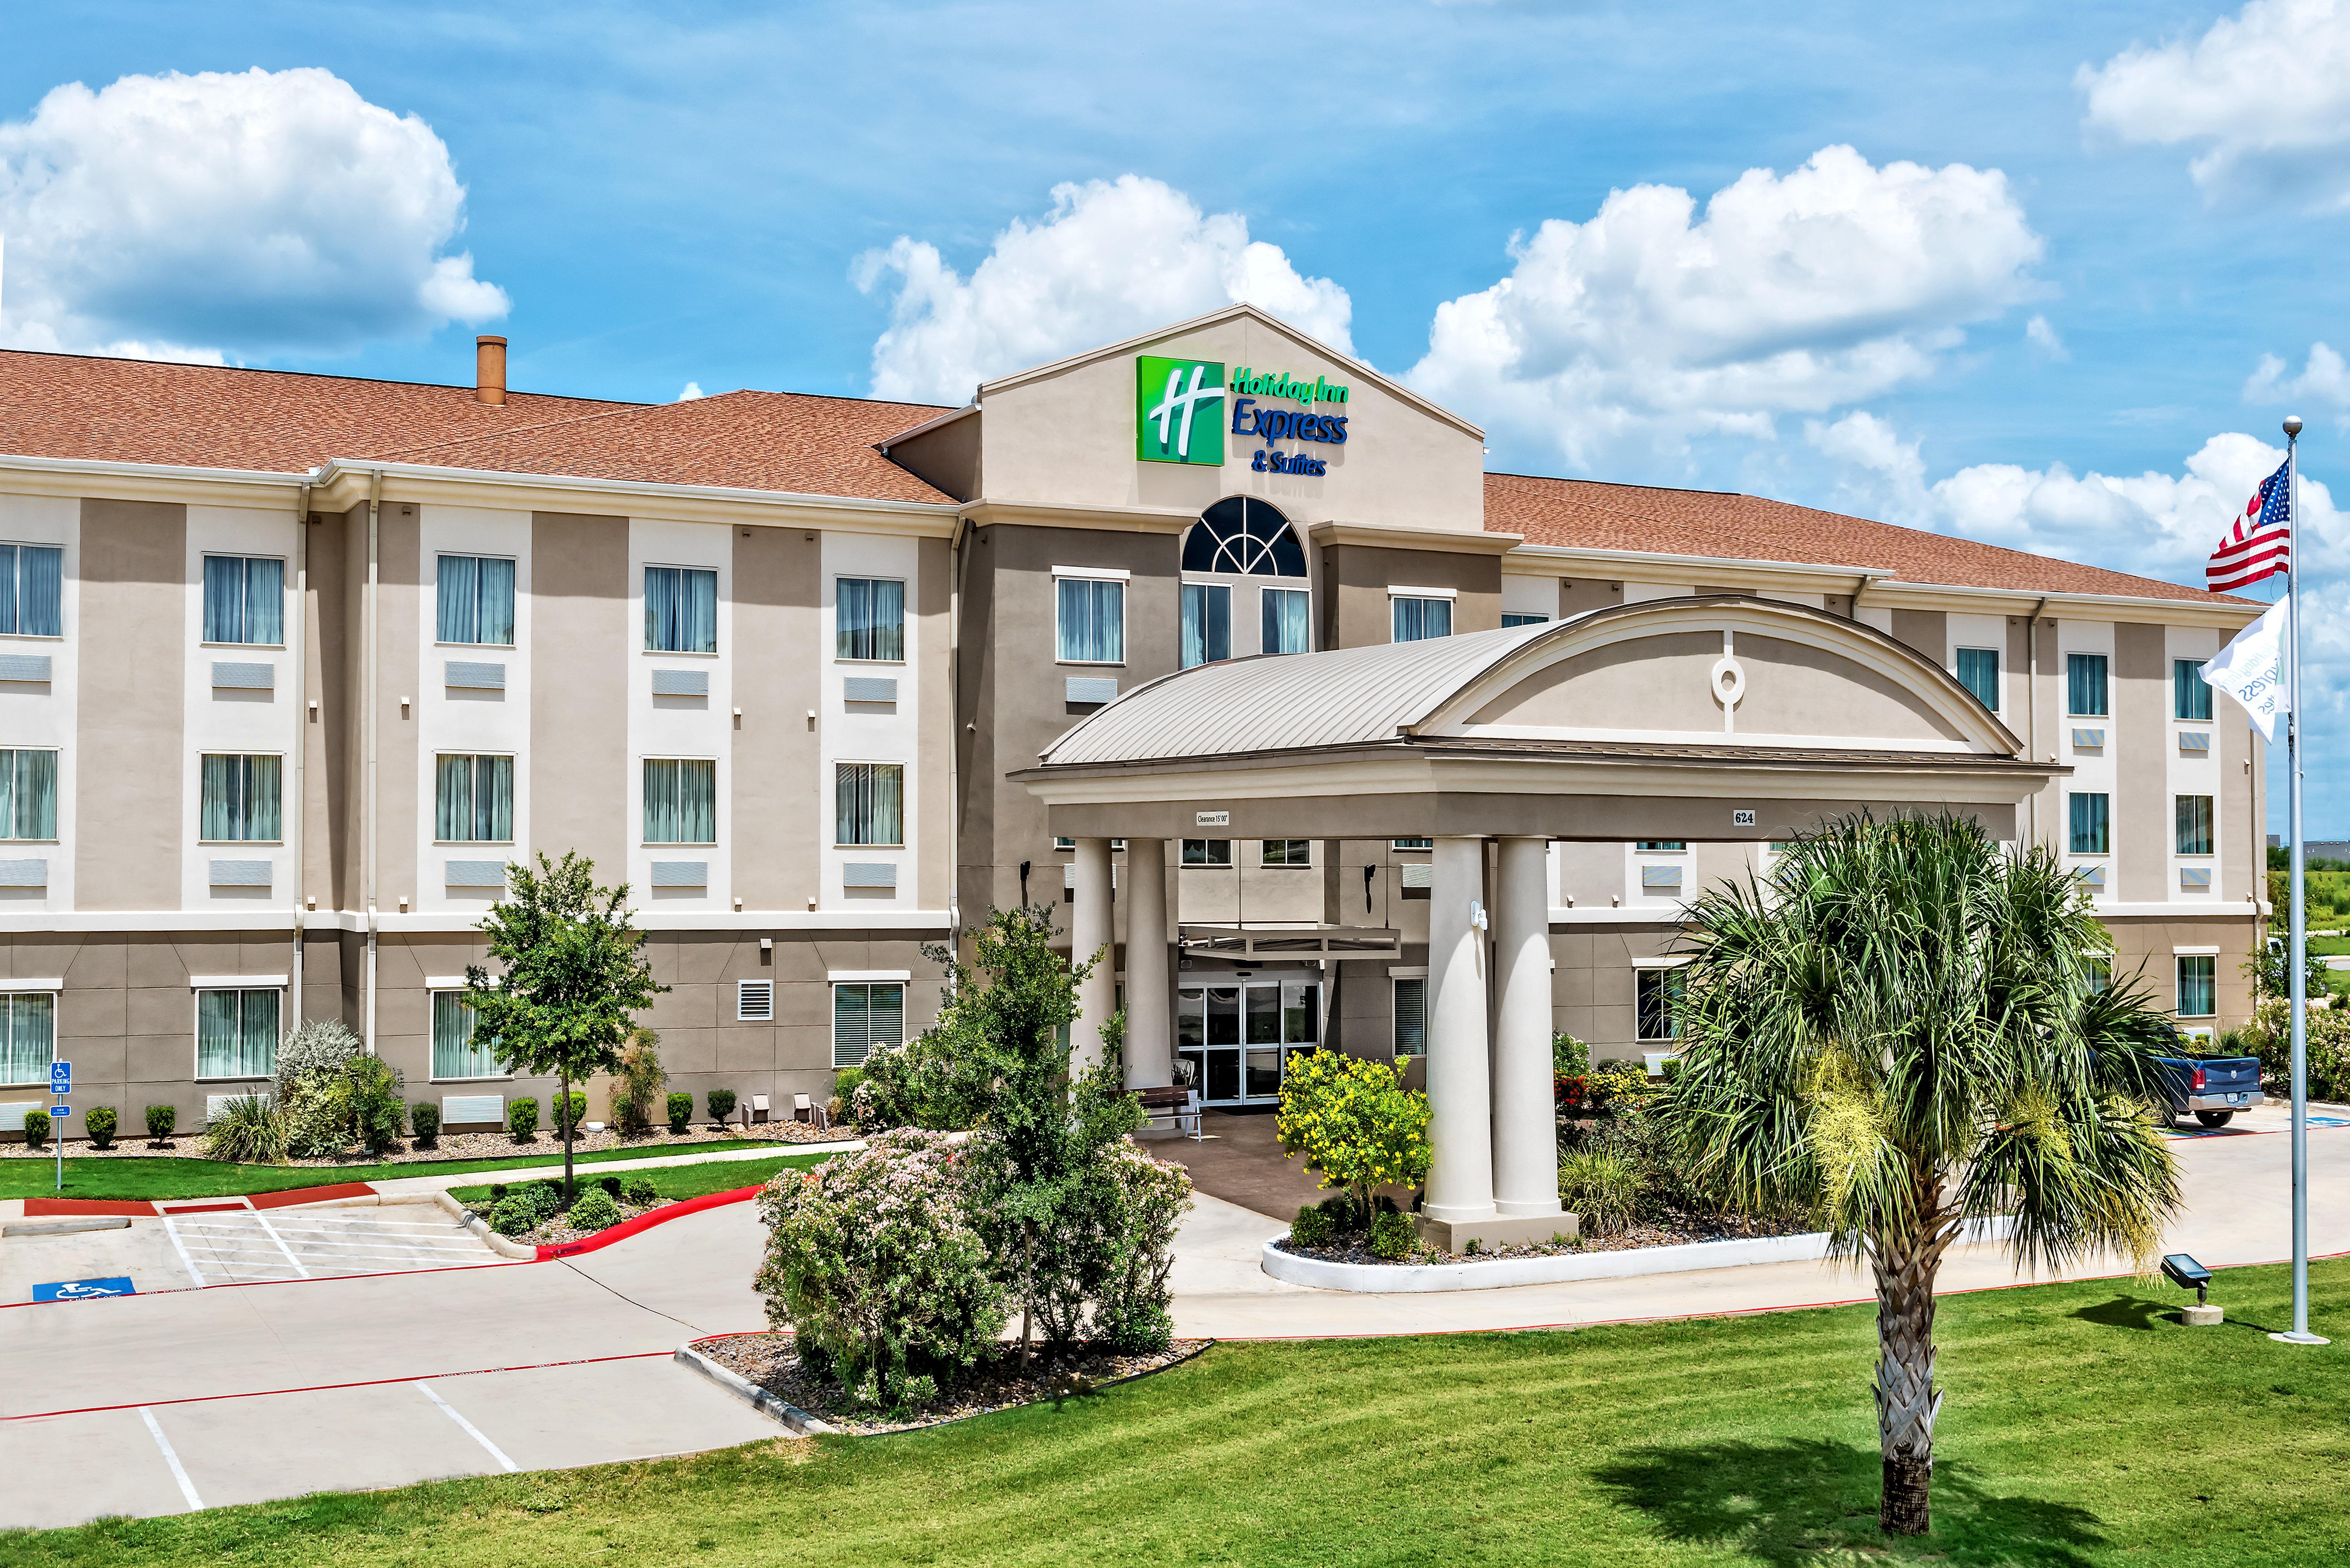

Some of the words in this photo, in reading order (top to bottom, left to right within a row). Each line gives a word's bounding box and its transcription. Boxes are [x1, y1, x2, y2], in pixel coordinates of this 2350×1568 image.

[1230, 367, 1315, 406] Holiday
[1316, 375, 1349, 403] Inn
[1231, 398, 1349, 447] Express
[1252, 450, 1267, 472] &
[1269, 451, 1327, 477] Suites
[1736, 812, 1753, 823] 624
